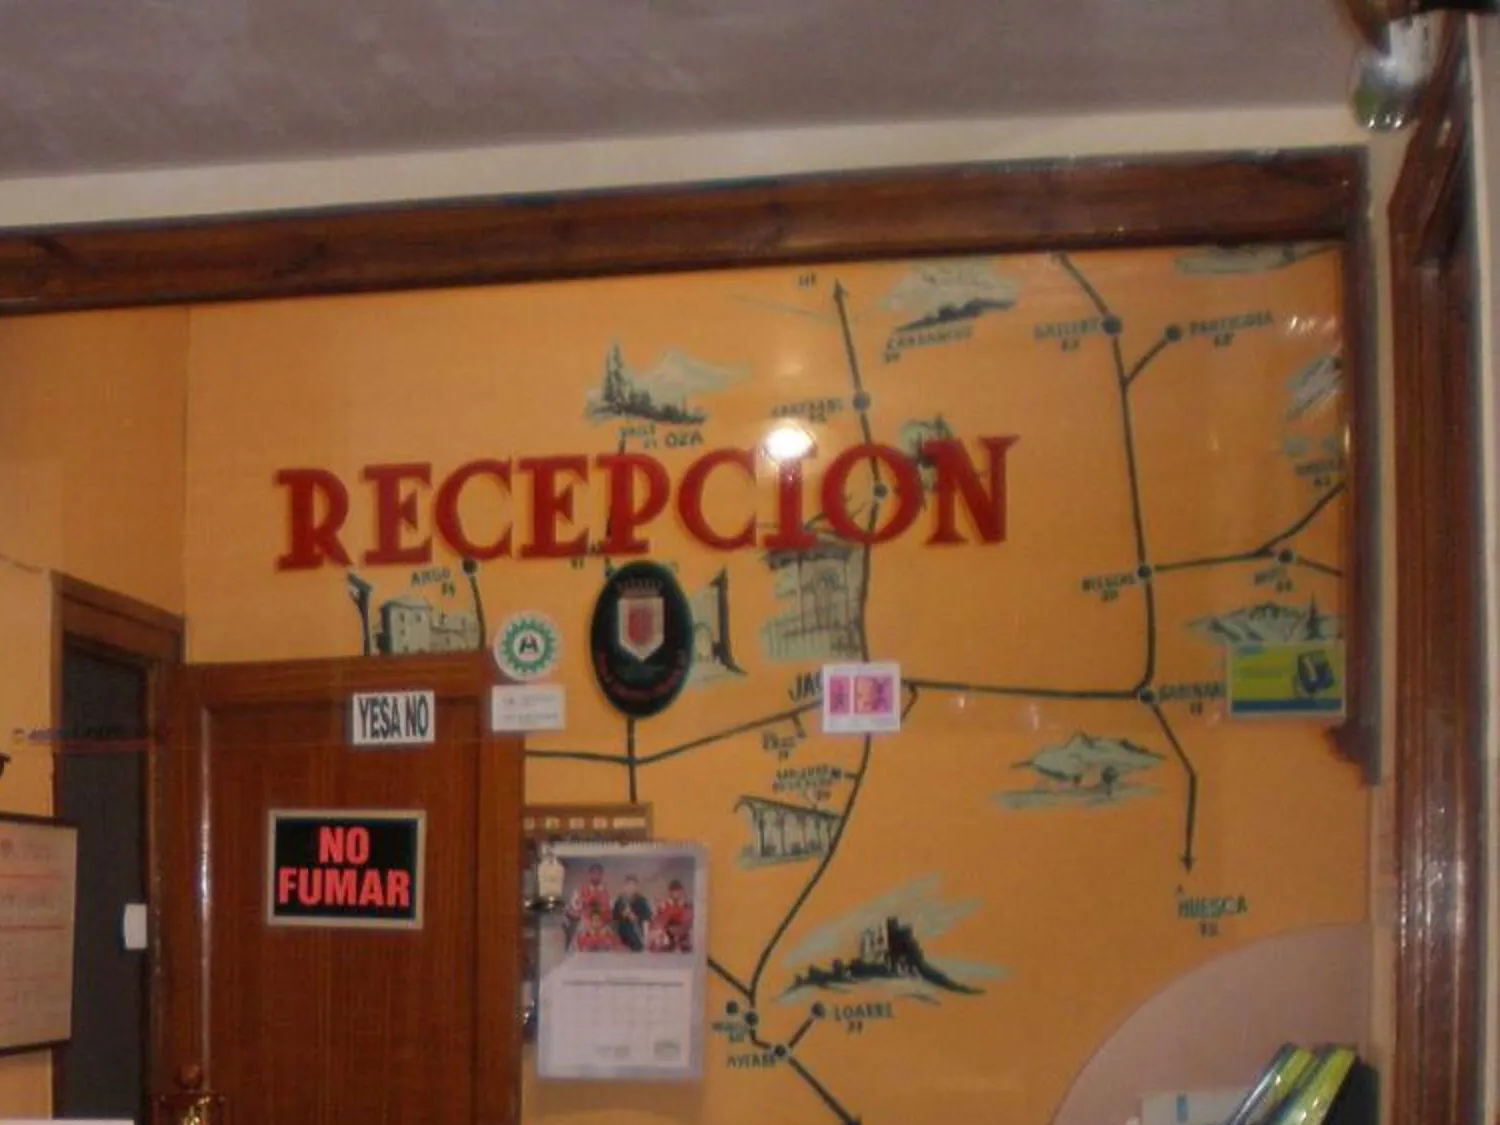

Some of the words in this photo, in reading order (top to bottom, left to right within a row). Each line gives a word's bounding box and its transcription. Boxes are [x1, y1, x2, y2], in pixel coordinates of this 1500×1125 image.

[273, 433, 1021, 570] RECEPCION
[359, 699, 402, 740] YESA
[405, 697, 430, 738] NO
[319, 826, 371, 866] NO
[278, 867, 412, 908] FUMAR
[1176, 895, 1248, 919] HUESCA
